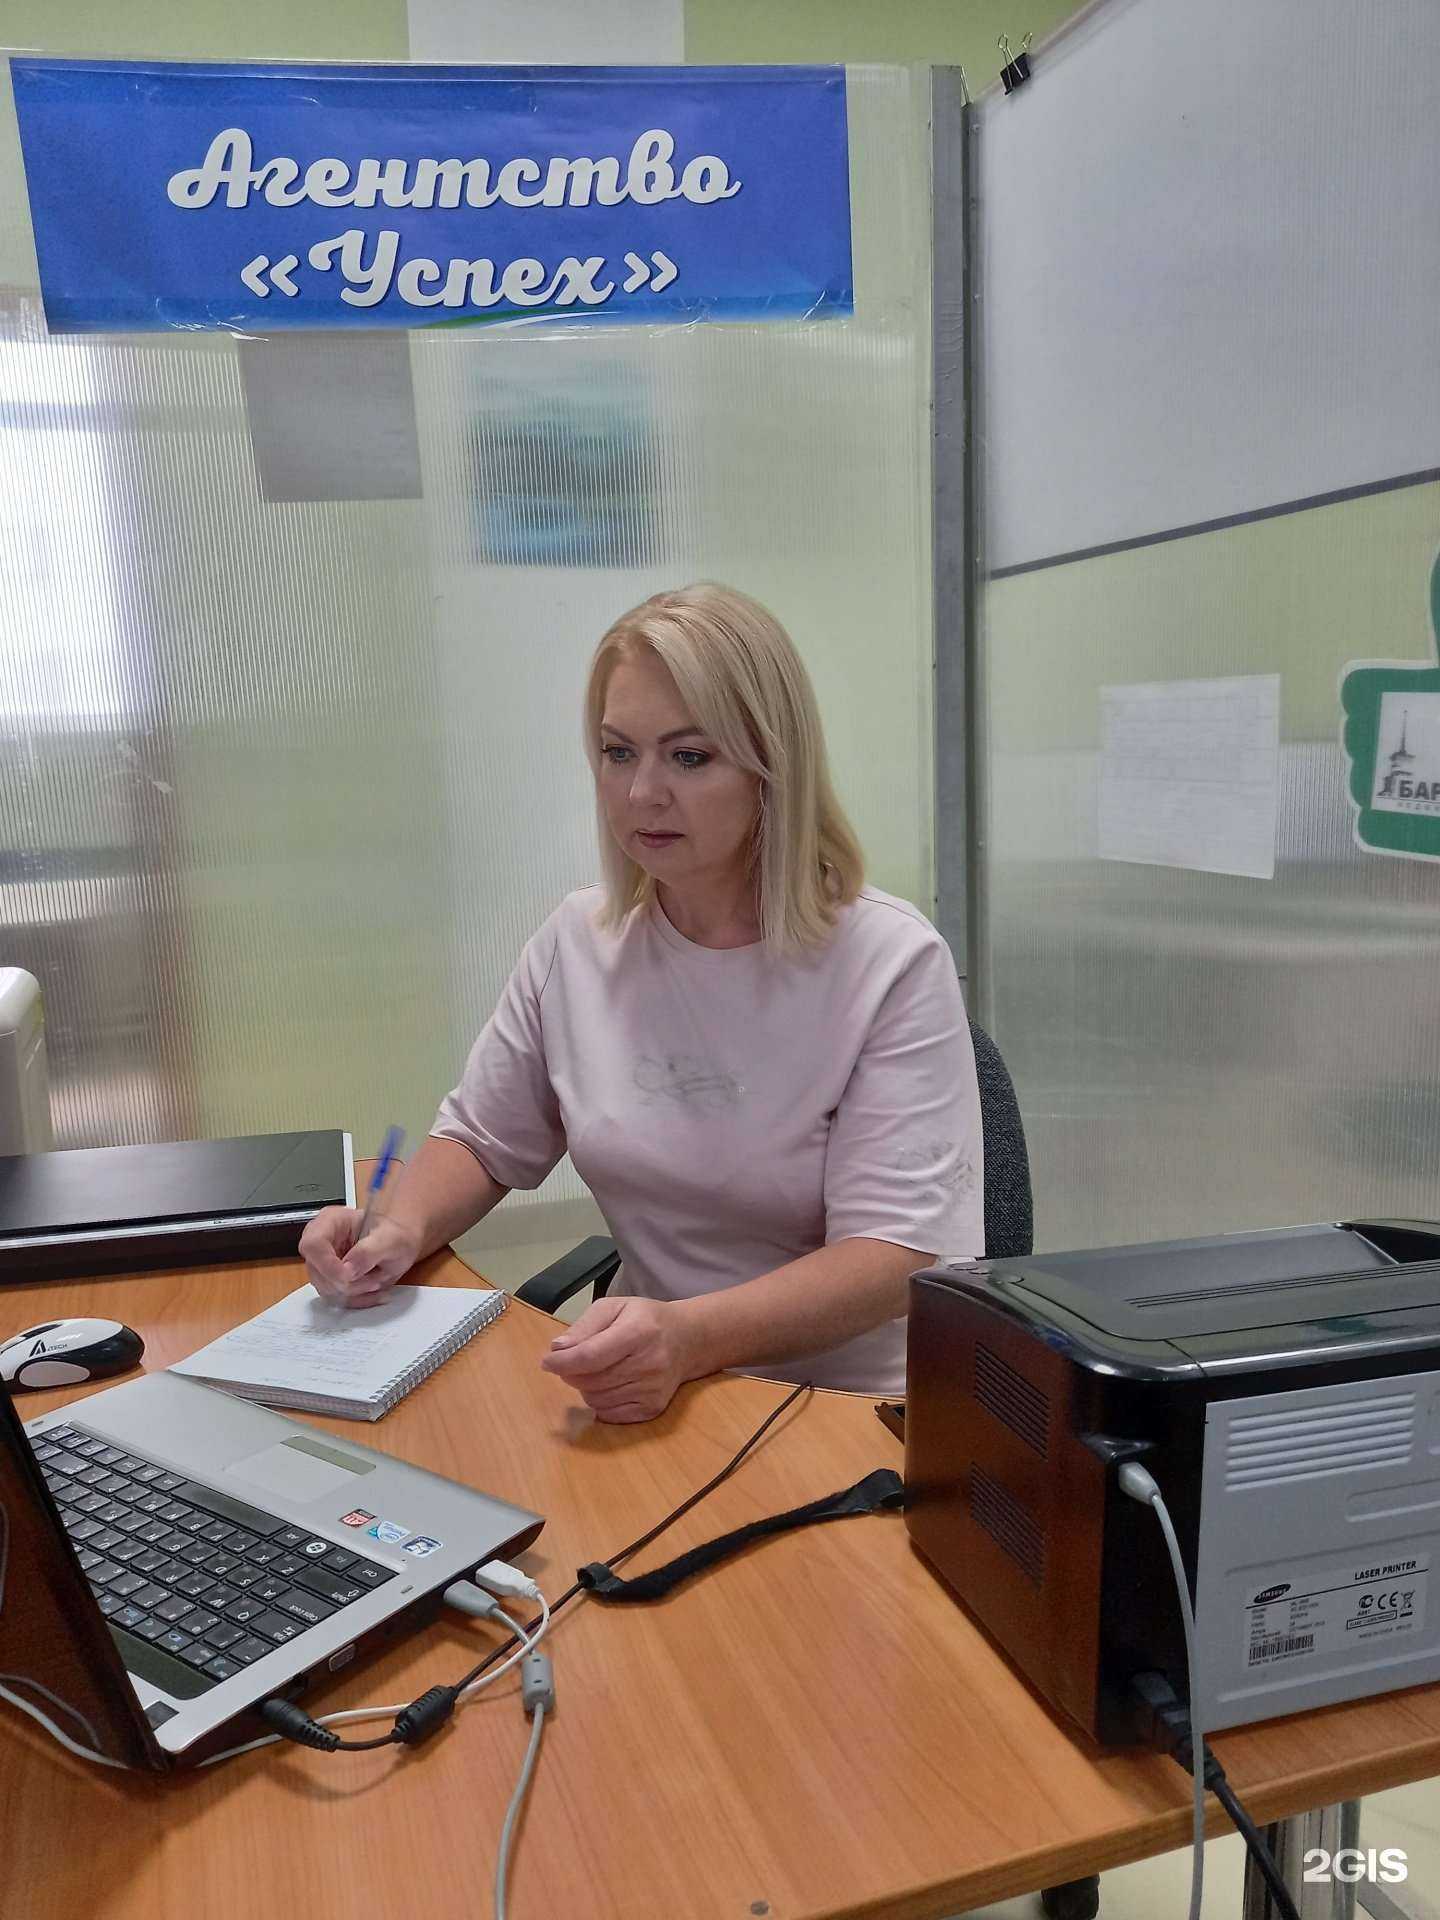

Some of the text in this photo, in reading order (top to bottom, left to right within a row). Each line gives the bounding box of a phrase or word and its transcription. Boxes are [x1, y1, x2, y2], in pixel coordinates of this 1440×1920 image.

[167, 128, 742, 208] Агентство
[1354, 1560, 1417, 1581] LASER PRINTER
